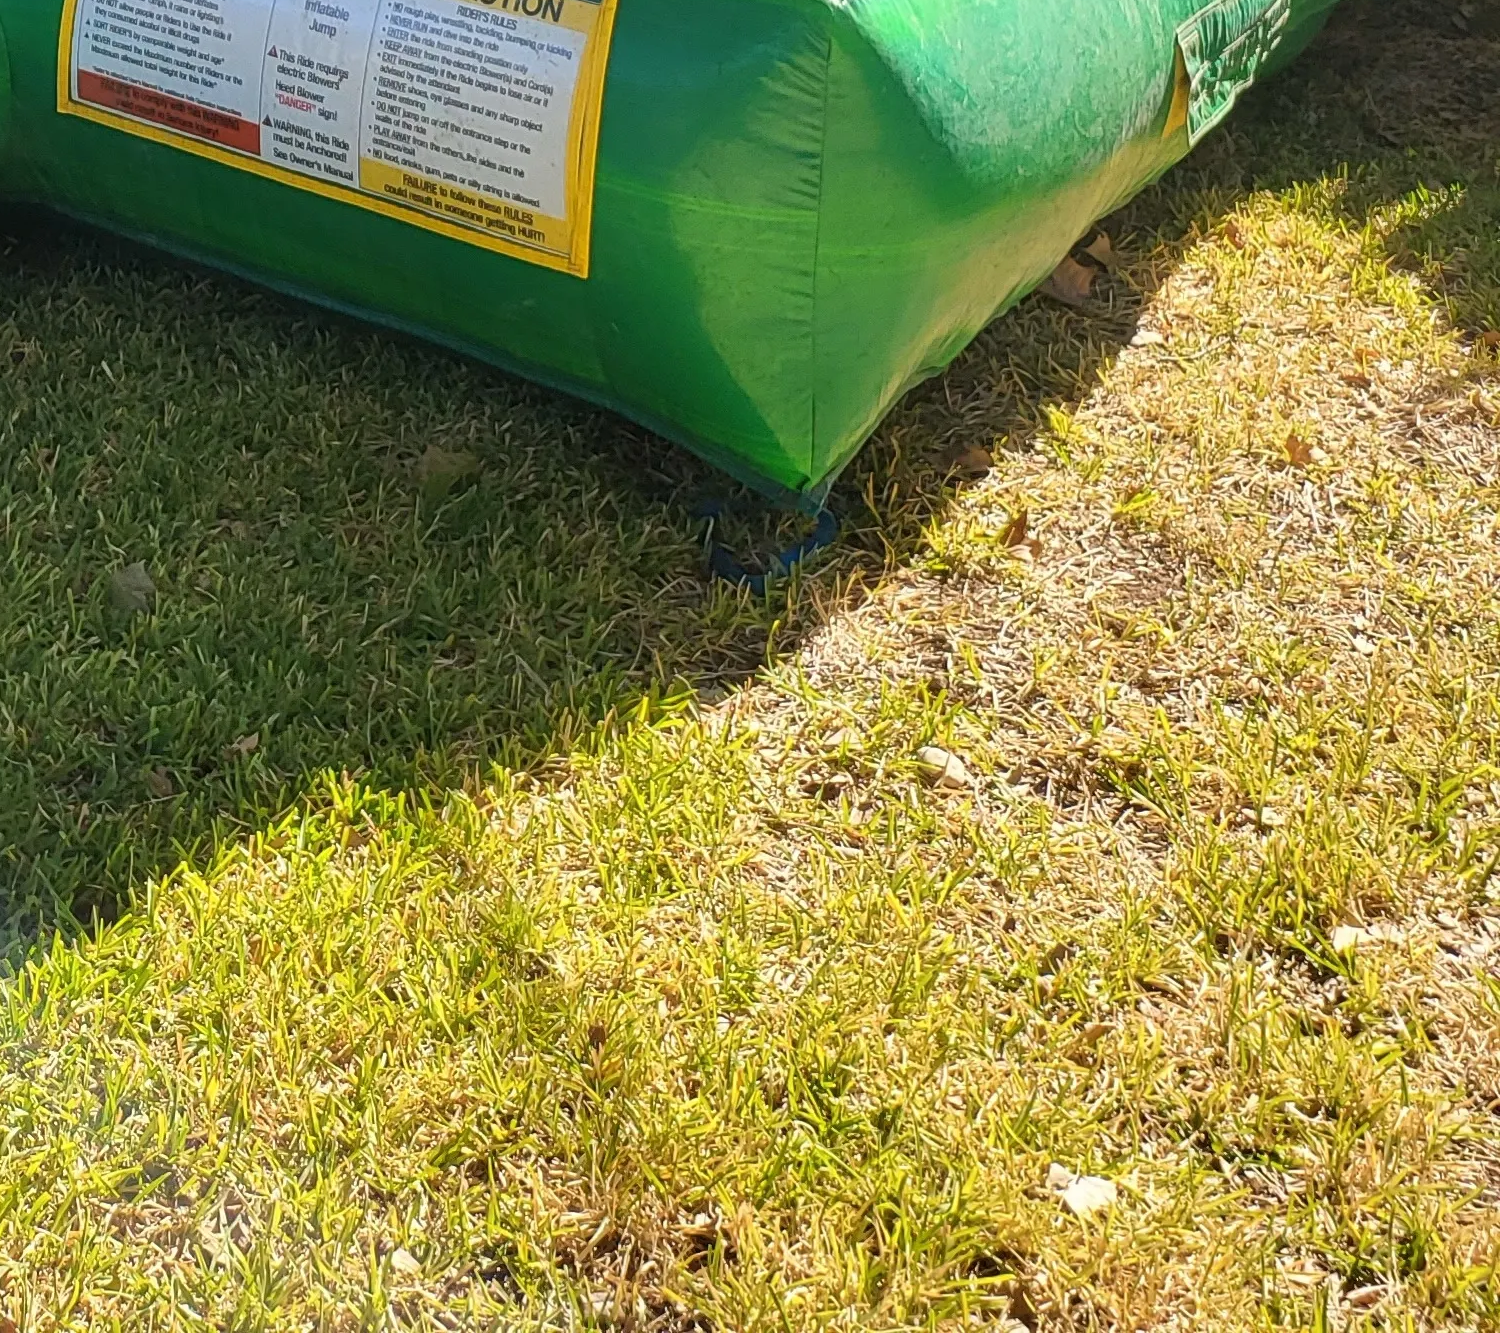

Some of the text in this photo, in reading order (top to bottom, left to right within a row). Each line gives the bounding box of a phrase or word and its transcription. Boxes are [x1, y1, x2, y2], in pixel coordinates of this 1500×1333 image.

[308, 17, 337, 39] Jump
[389, 13, 412, 29] NEVER
[412, 19, 428, 33] RUN
[428, 24, 442, 36] and
[473, 37, 484, 48] the
[403, 5, 423, 19] rough
[536, 42, 545, 51] or
[456, 4, 518, 30] RIDER'S RULES
[278, 48, 349, 81] This Ride requires
[384, 39, 401, 52] KEEP
[401, 43, 422, 58] AWAY
[423, 50, 439, 62] from
[440, 55, 452, 65] the
[513, 75, 527, 87] and
[387, 26, 409, 41] ENTER
[410, 32, 420, 43] the
[436, 40, 453, 52] from
[453, 45, 483, 63] standing
[483, 54, 512, 70] position
[512, 62, 528, 75] only
[276, 62, 306, 80] electric
[382, 51, 397, 64] EXIT
[445, 69, 457, 81] the
[458, 73, 473, 85] Ride
[474, 78, 498, 94] begins
[499, 85, 506, 95] to
[533, 96, 542, 105] or
[405, 71, 414, 82] by
[415, 74, 426, 84] the
[275, 79, 324, 103] Heed Blower
[318, 105, 337, 123] sign!
[376, 100, 386, 112] DO
[420, 115, 429, 124] on
[449, 122, 461, 134] the
[510, 141, 518, 150] or
[518, 143, 531, 155] the
[393, 117, 400, 127] of
[401, 120, 412, 130] the
[470, 103, 484, 114] and
[484, 108, 498, 120] any
[499, 111, 520, 127] sharp
[520, 117, 543, 134] object
[272, 130, 292, 146] must
[294, 137, 304, 150] be
[273, 117, 349, 152] WARNING, this Ride
[373, 124, 390, 138] PLAY
[412, 135, 428, 148] from
[429, 141, 440, 152] the
[497, 162, 511, 174] and
[273, 145, 353, 182] See Owner's Manual
[459, 176, 466, 185] or
[384, 181, 407, 198] could
[434, 197, 442, 209] in
[485, 214, 515, 236] getting
[402, 173, 533, 226] FAILURE to follow these RULES
